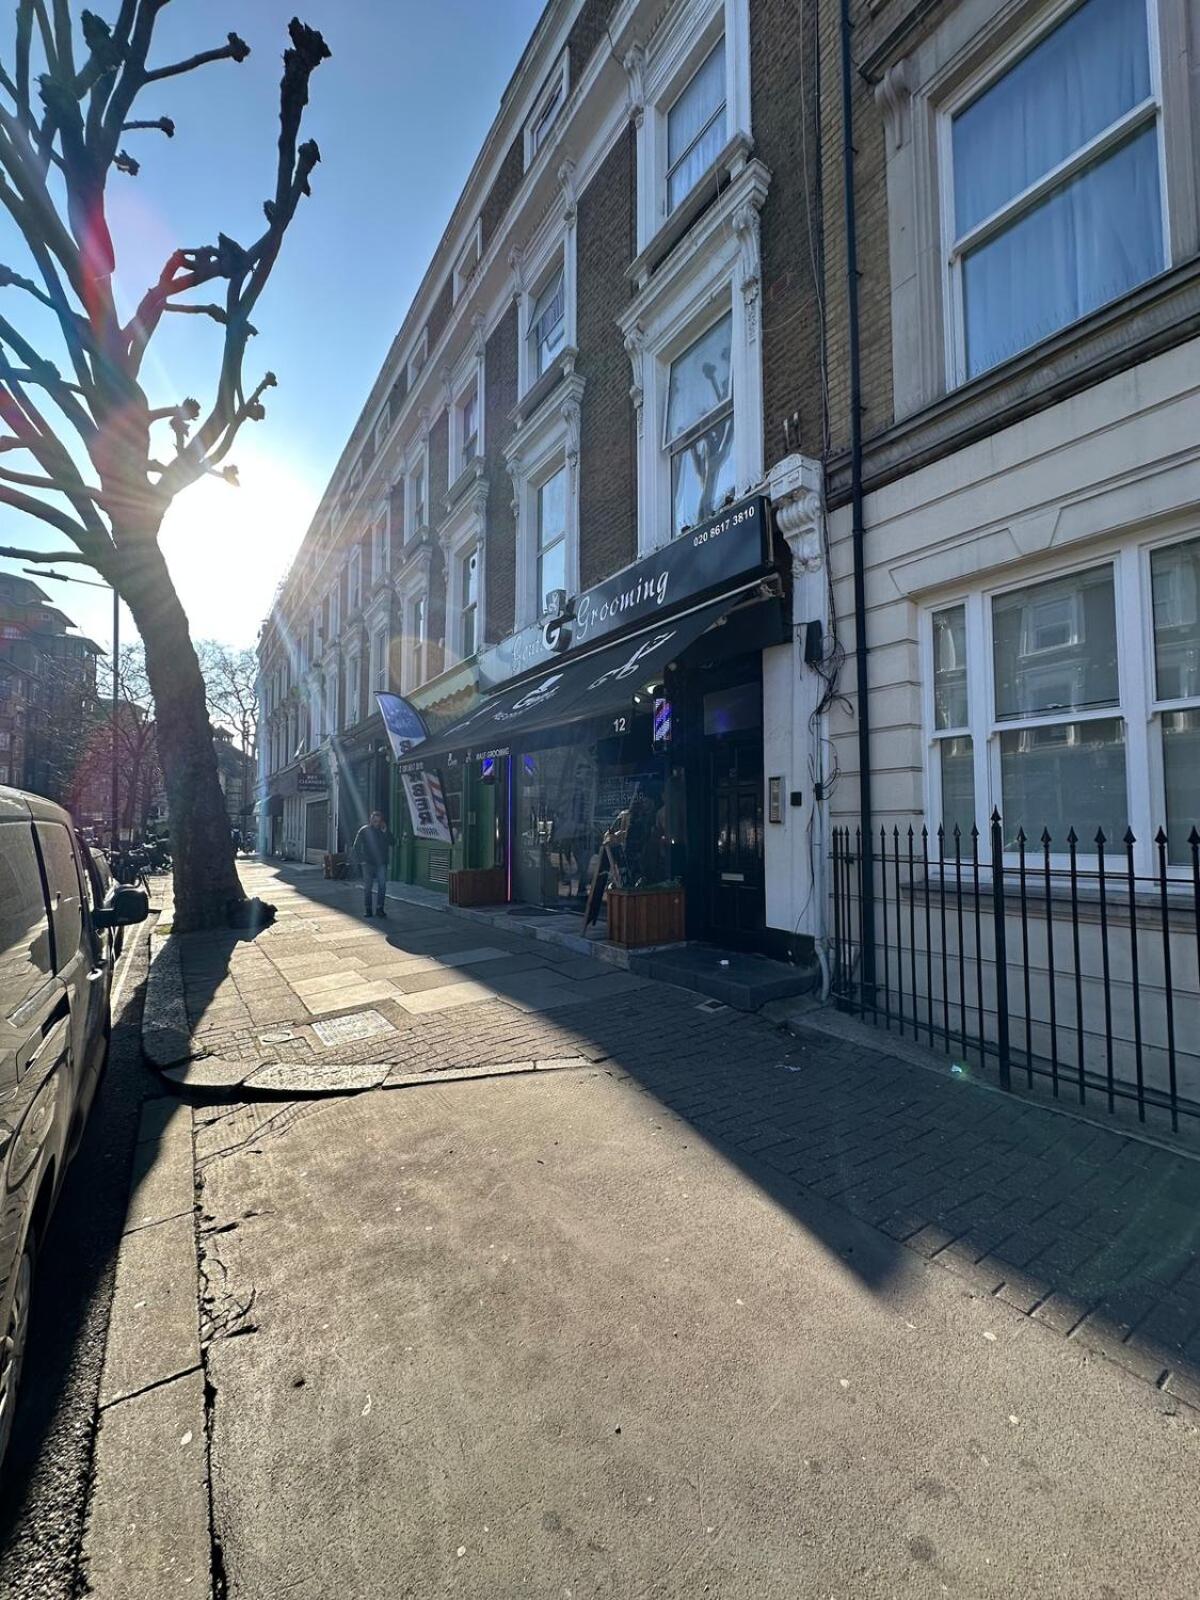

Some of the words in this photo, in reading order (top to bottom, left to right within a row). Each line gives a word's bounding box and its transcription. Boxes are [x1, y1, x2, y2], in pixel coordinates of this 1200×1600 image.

[693, 531, 708, 547] 020
[709, 518, 730, 538] 8617
[732, 505, 755, 526] 3810
[576, 571, 669, 640] Grooming
[613, 717, 626, 732] 12
